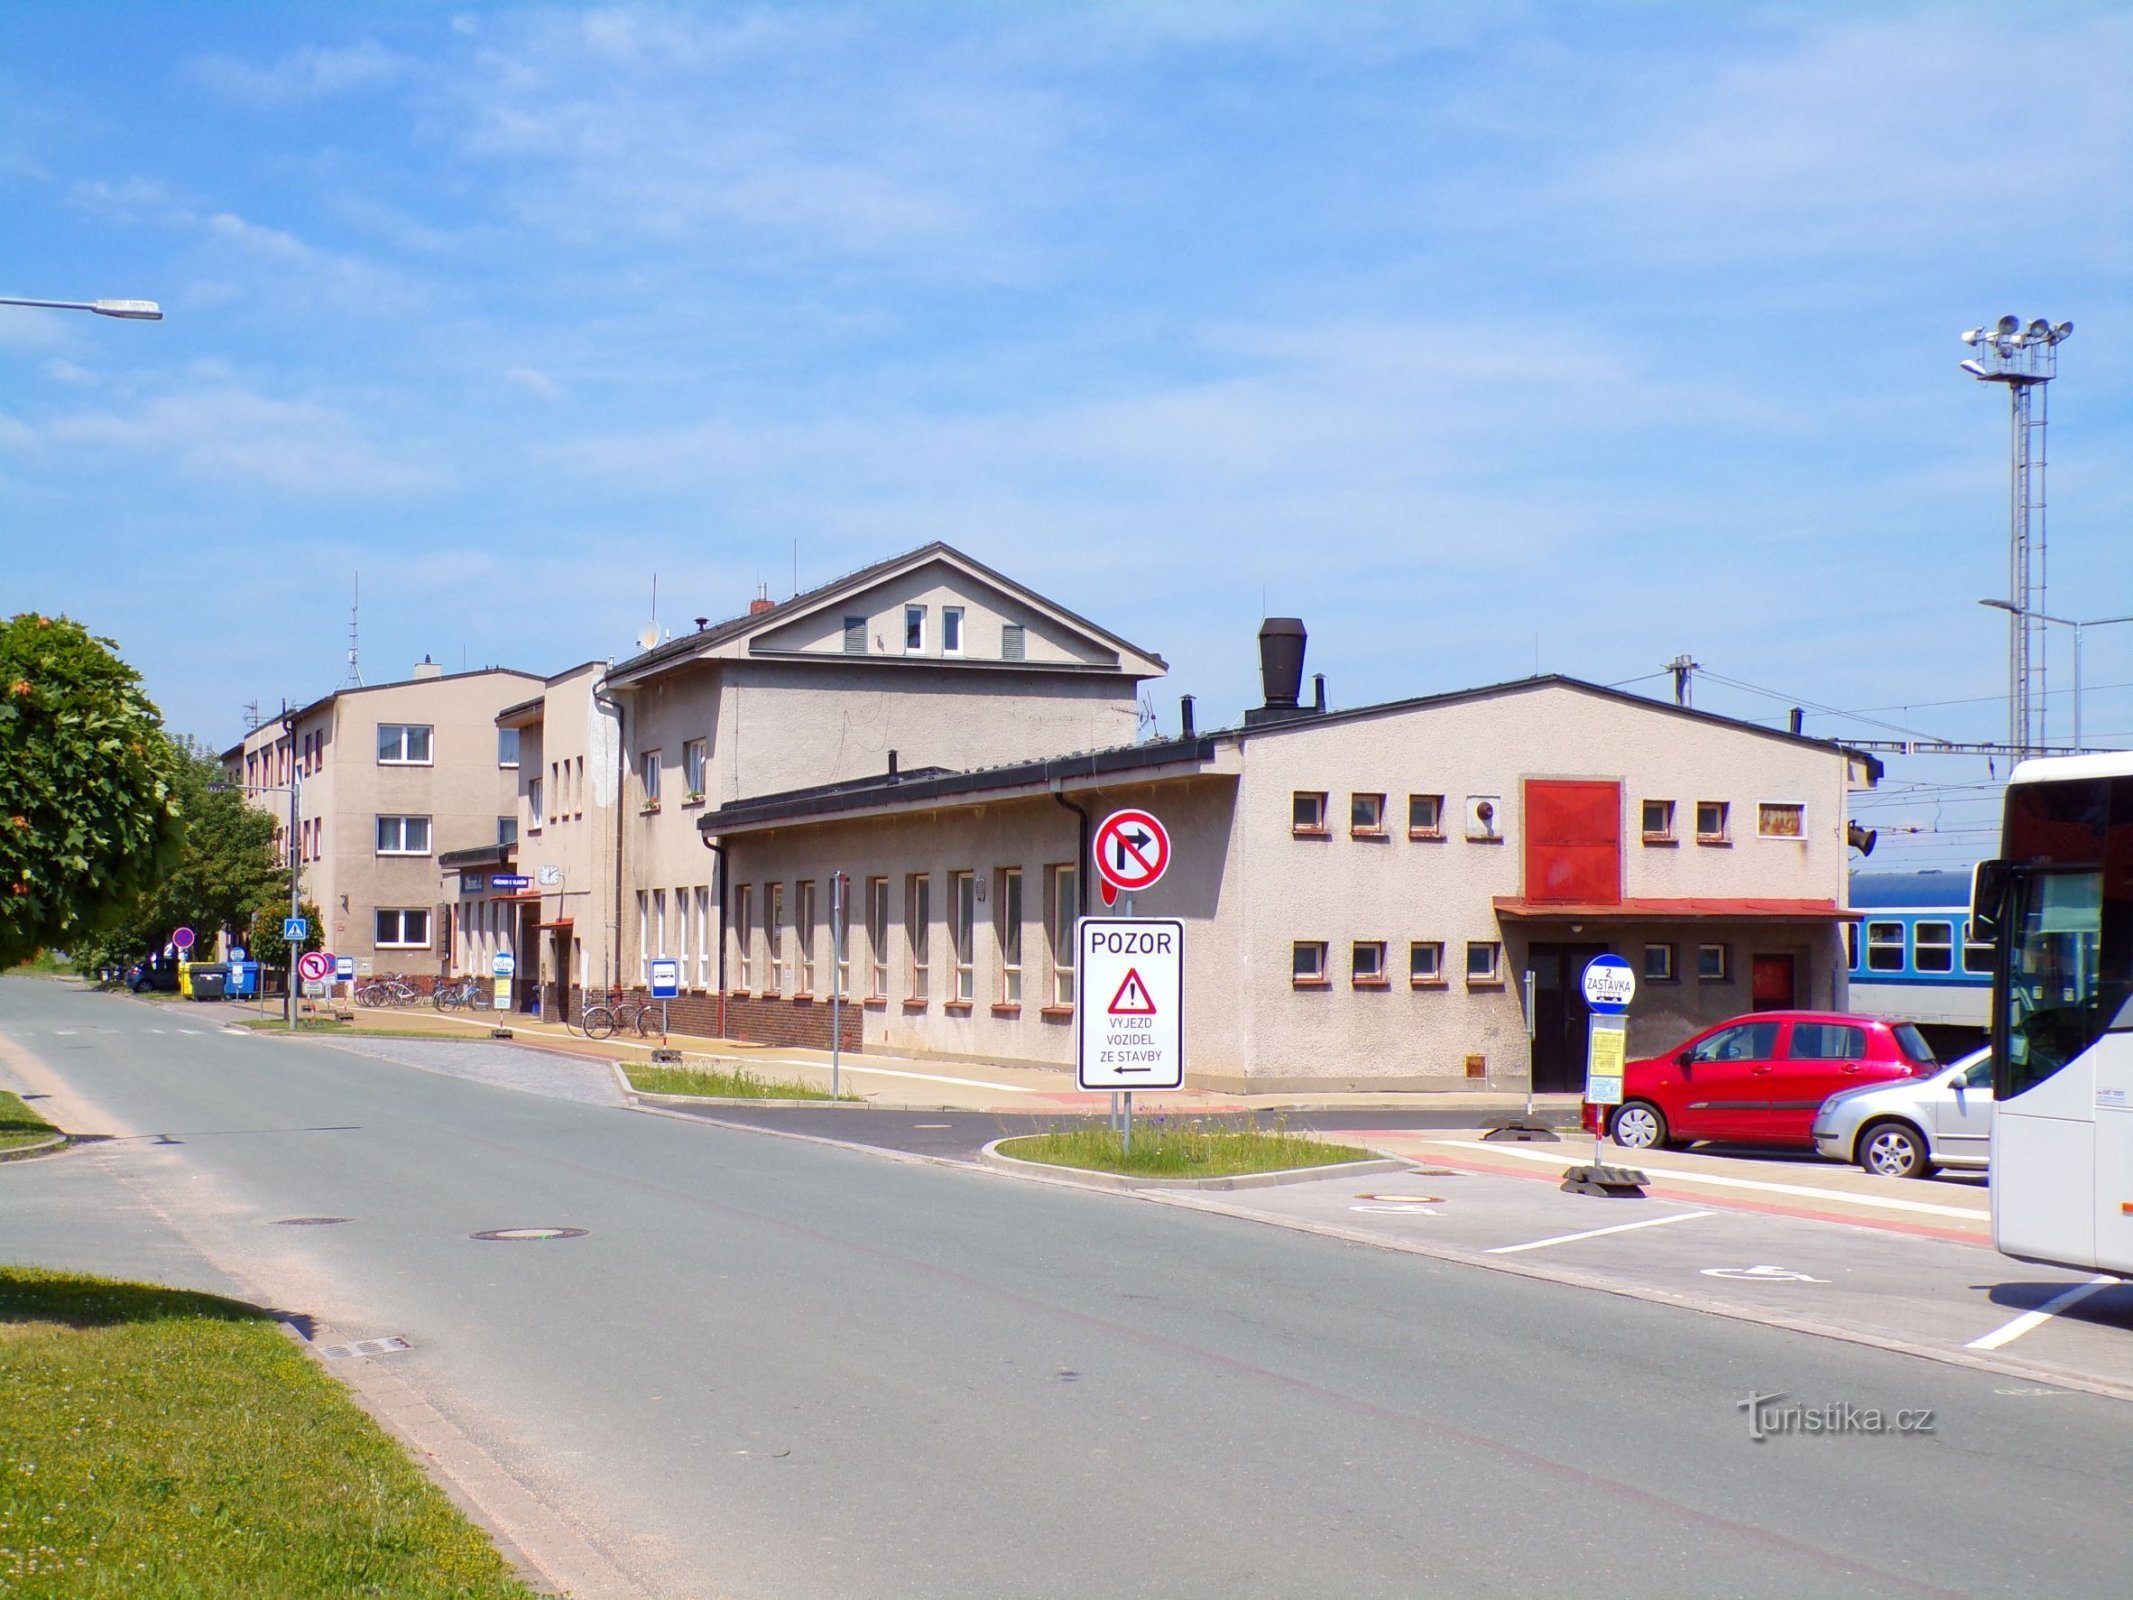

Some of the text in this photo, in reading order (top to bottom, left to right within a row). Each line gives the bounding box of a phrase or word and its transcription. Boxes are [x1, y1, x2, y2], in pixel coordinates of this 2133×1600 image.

[1092, 932, 1171, 954] POZOR
[1605, 968, 1612, 978] 2
[1587, 976, 1631, 992] ZASTÁVKA
[1109, 1016, 1152, 1029] VÝJEZD
[1107, 1034, 1155, 1046] VOZIDEL
[1100, 1050, 1162, 1063] ZE STAVBY
